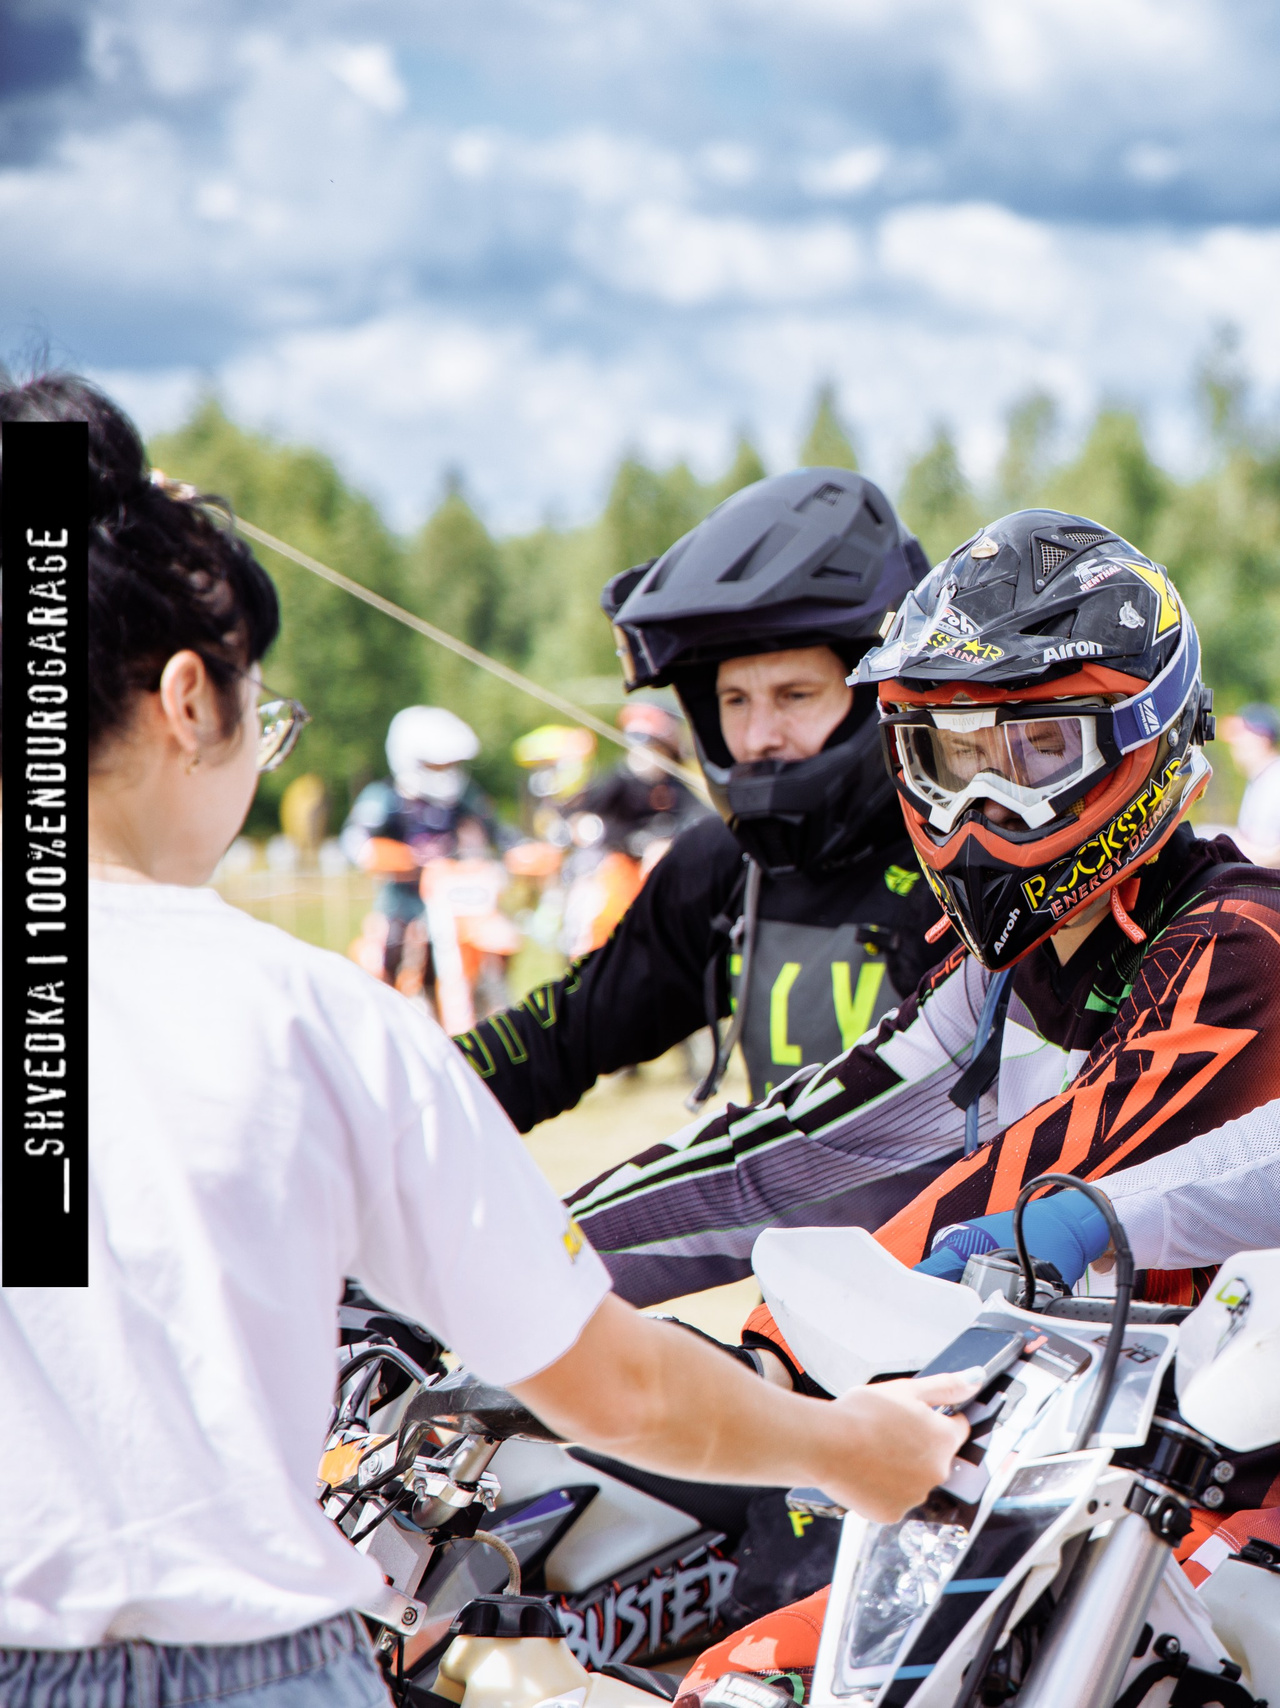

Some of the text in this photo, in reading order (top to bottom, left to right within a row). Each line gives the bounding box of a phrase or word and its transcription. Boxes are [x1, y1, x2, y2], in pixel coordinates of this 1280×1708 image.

[1080, 565, 1122, 592] RENTHAL
[1050, 850, 1124, 917] ENERGY
[1127, 798, 1173, 853] DRINK
[993, 907, 1021, 955] Airoh
